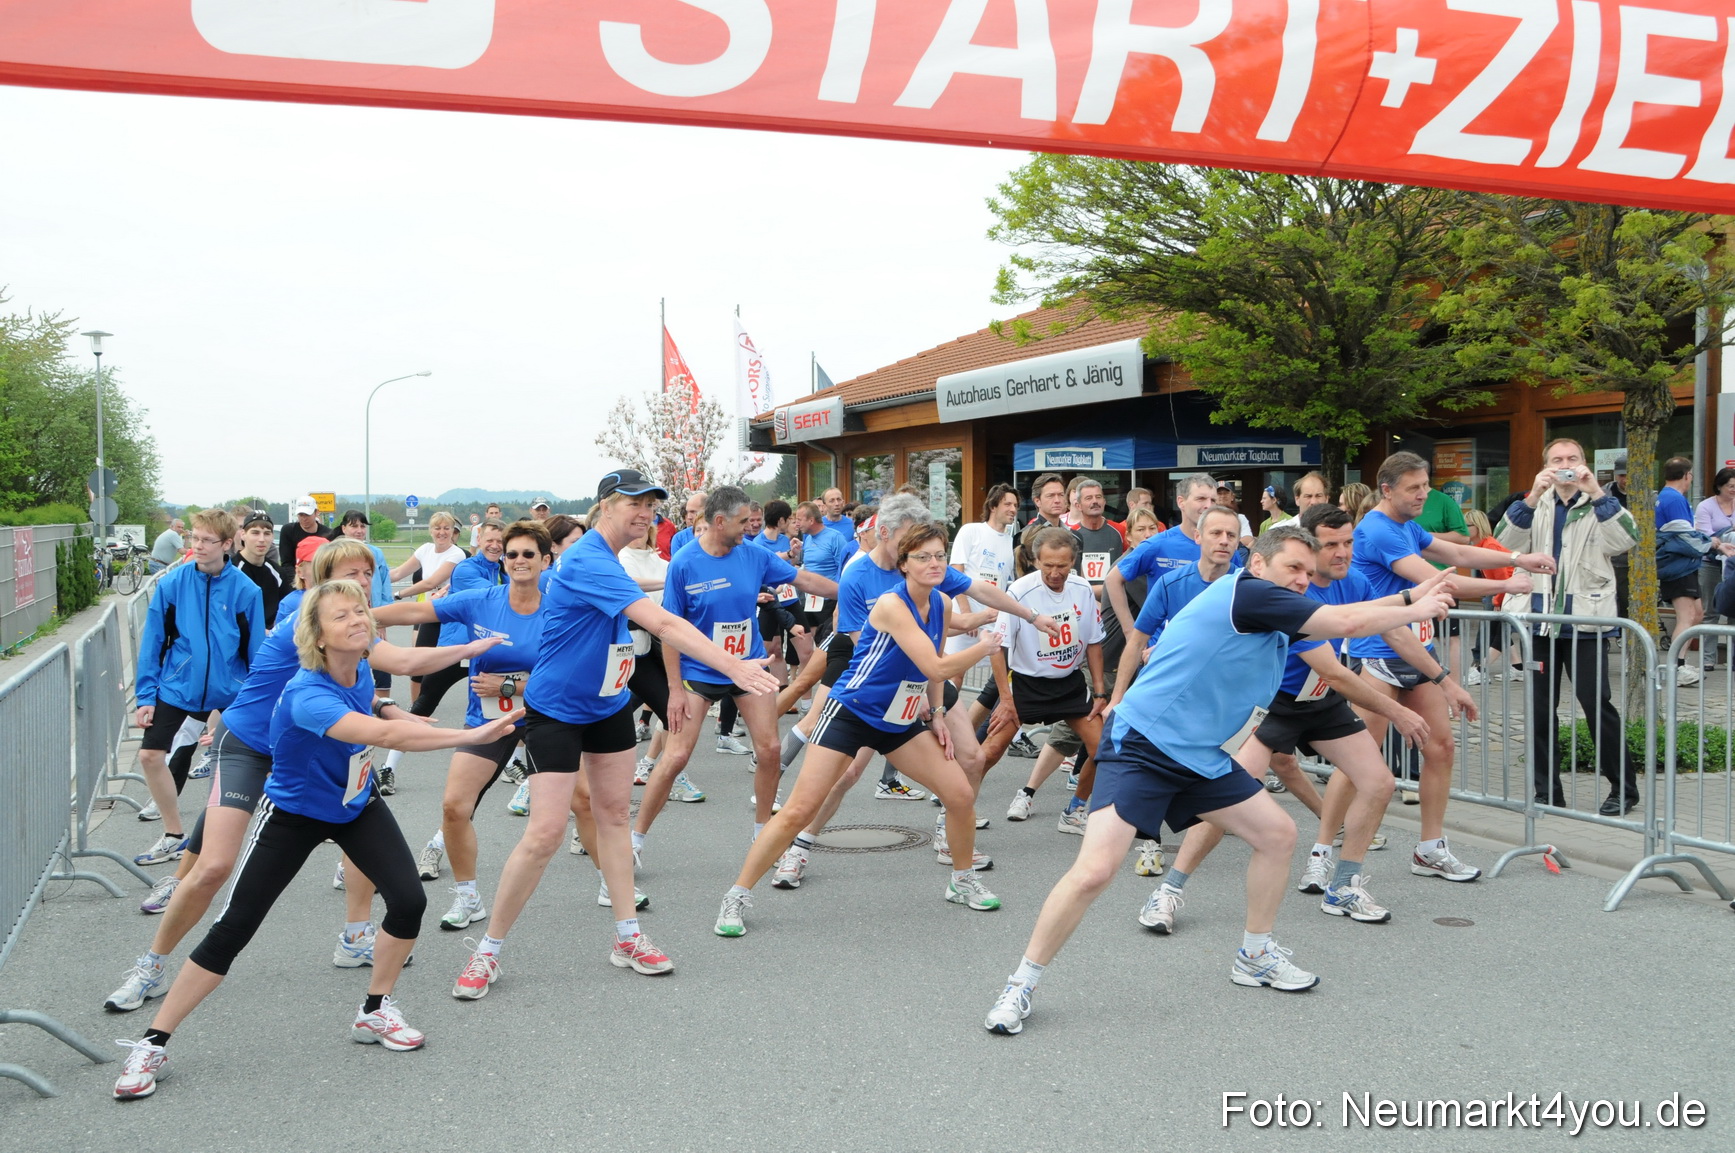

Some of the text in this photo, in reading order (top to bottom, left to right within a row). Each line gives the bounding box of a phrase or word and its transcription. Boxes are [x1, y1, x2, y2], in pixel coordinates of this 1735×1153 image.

[946, 361, 1124, 407] Autohaus Gerhart & Jänig
[793, 409, 831, 430] SEAT
[1046, 453, 1092, 466] Neumarkter Tagblatt
[1201, 449, 1280, 463] Neumarkter Tagblatt
[1087, 561, 1104, 578] 87
[724, 633, 745, 656] 64
[615, 658, 633, 689] 21
[901, 695, 921, 720] 10
[225, 791, 250, 801] ODLO
